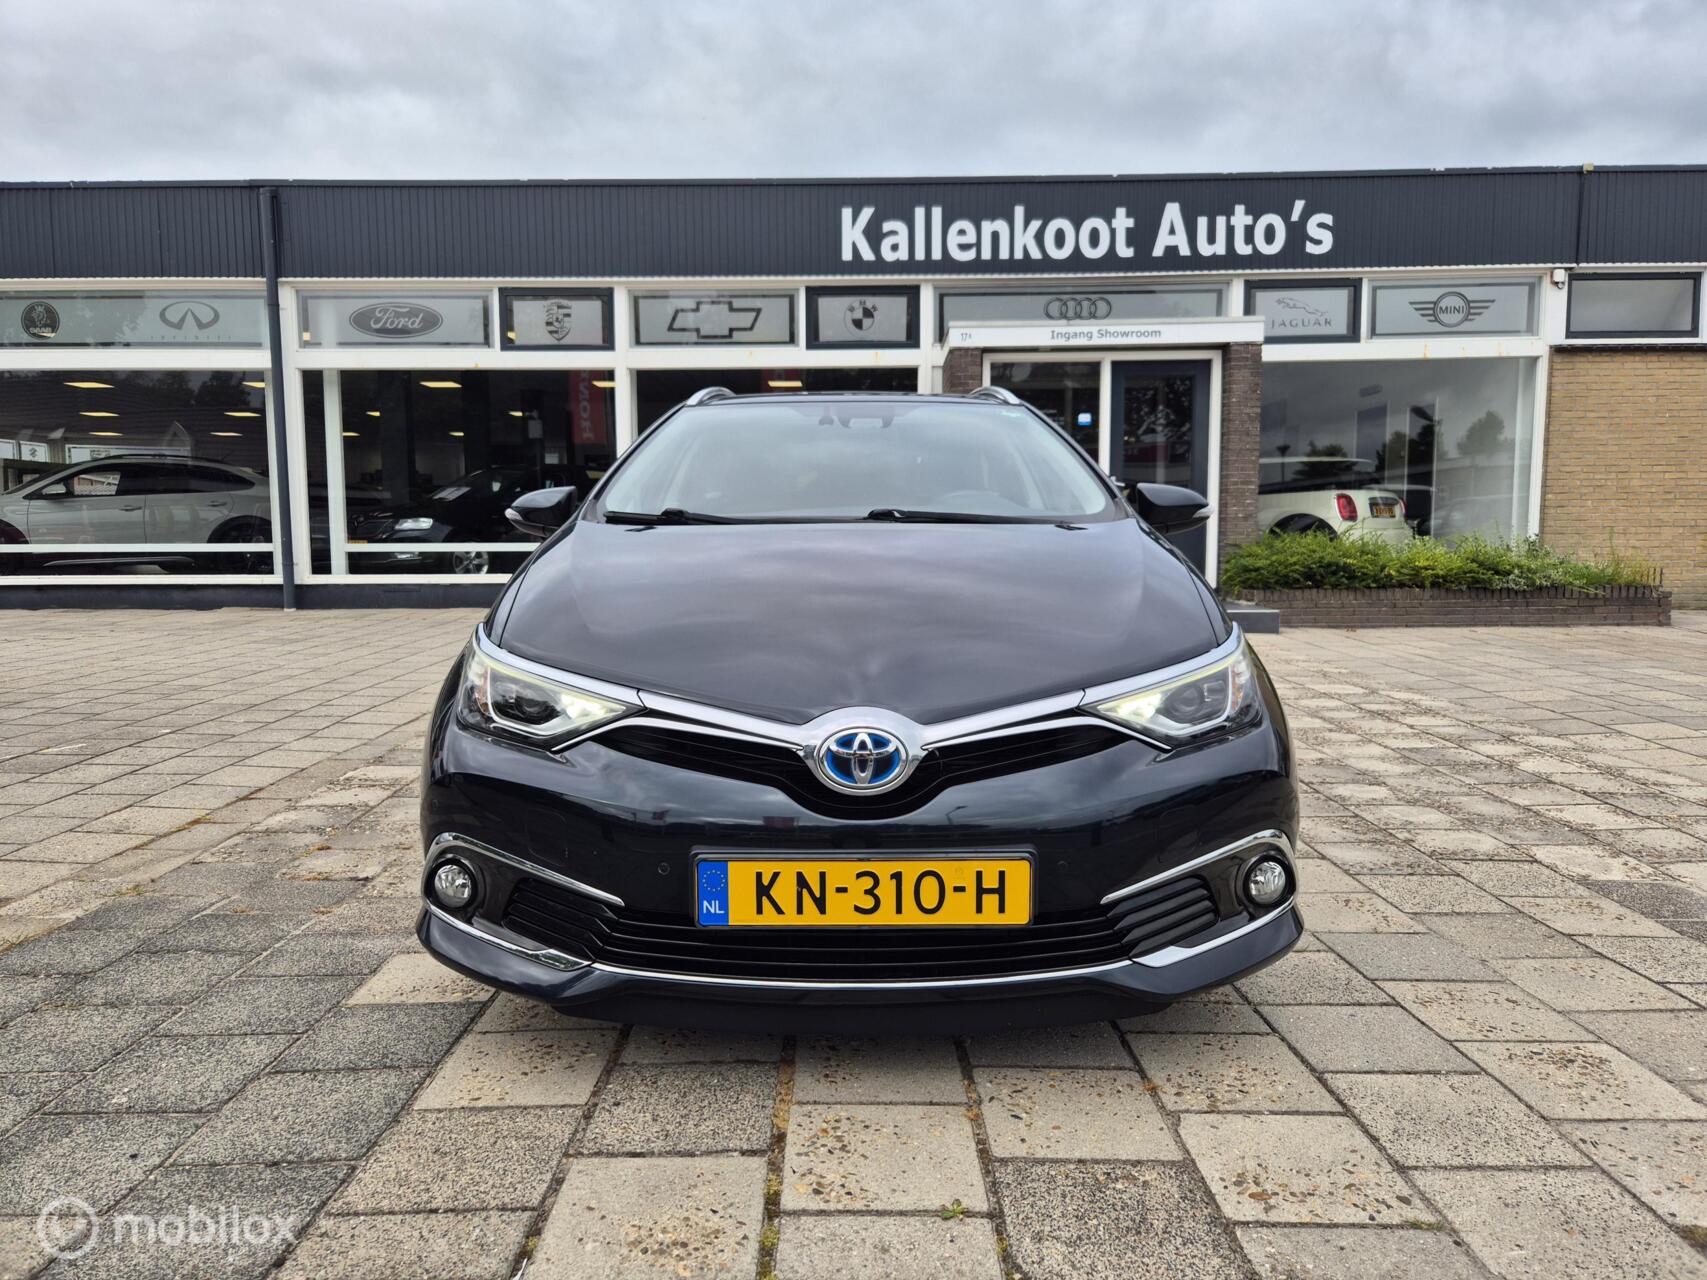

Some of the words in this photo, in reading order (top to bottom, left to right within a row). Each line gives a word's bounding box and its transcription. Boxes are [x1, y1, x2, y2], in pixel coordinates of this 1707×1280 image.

[840, 204, 1135, 262] Kallenkoot
[1152, 199, 1334, 257] Auto's
[370, 306, 424, 329] Ford
[1438, 305, 1465, 315] MINI
[1271, 318, 1332, 329] JAGUAR
[1050, 330, 1093, 341] Ingang
[1096, 328, 1162, 339] Showroom
[755, 869, 1006, 916] KN-310-H
[703, 899, 725, 914] NL
